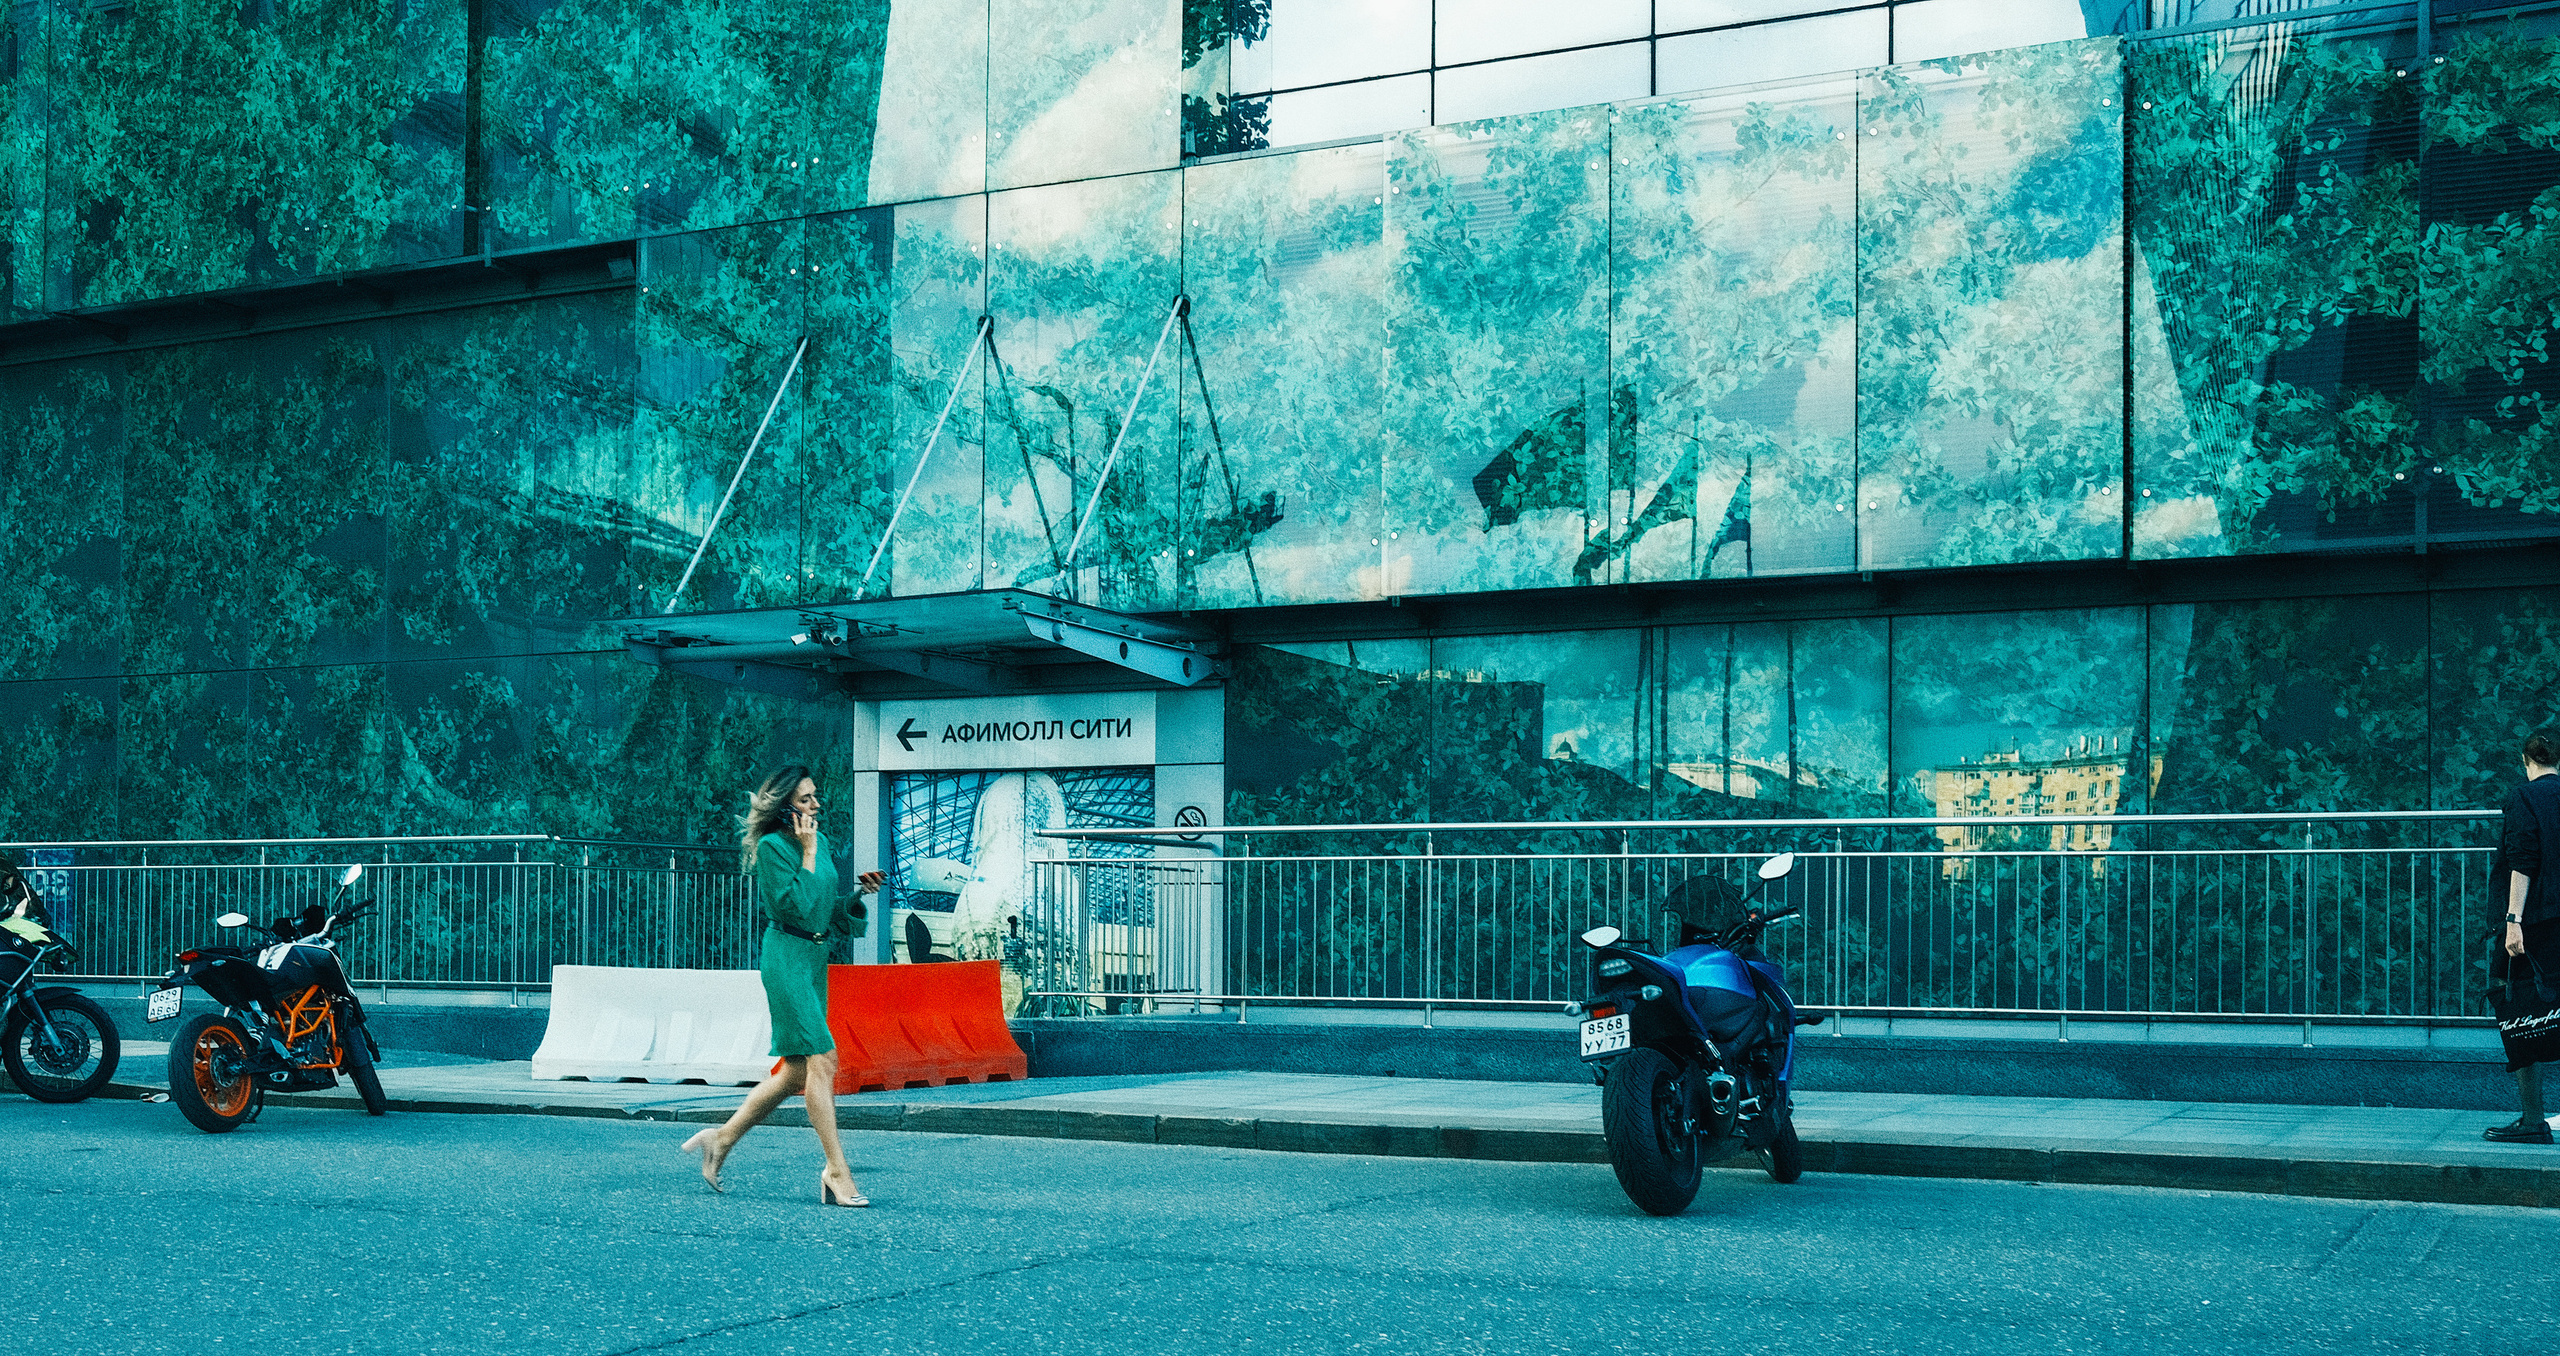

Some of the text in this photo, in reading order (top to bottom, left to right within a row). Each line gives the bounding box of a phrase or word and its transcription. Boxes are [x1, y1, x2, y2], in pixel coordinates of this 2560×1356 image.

[941, 718, 1131, 743] АФИМОЛЛ СИТИ
[1588, 1018, 1623, 1034] 8568
[2498, 1017, 2520, 1031] Karl
[1609, 1035, 1626, 1048] 77
